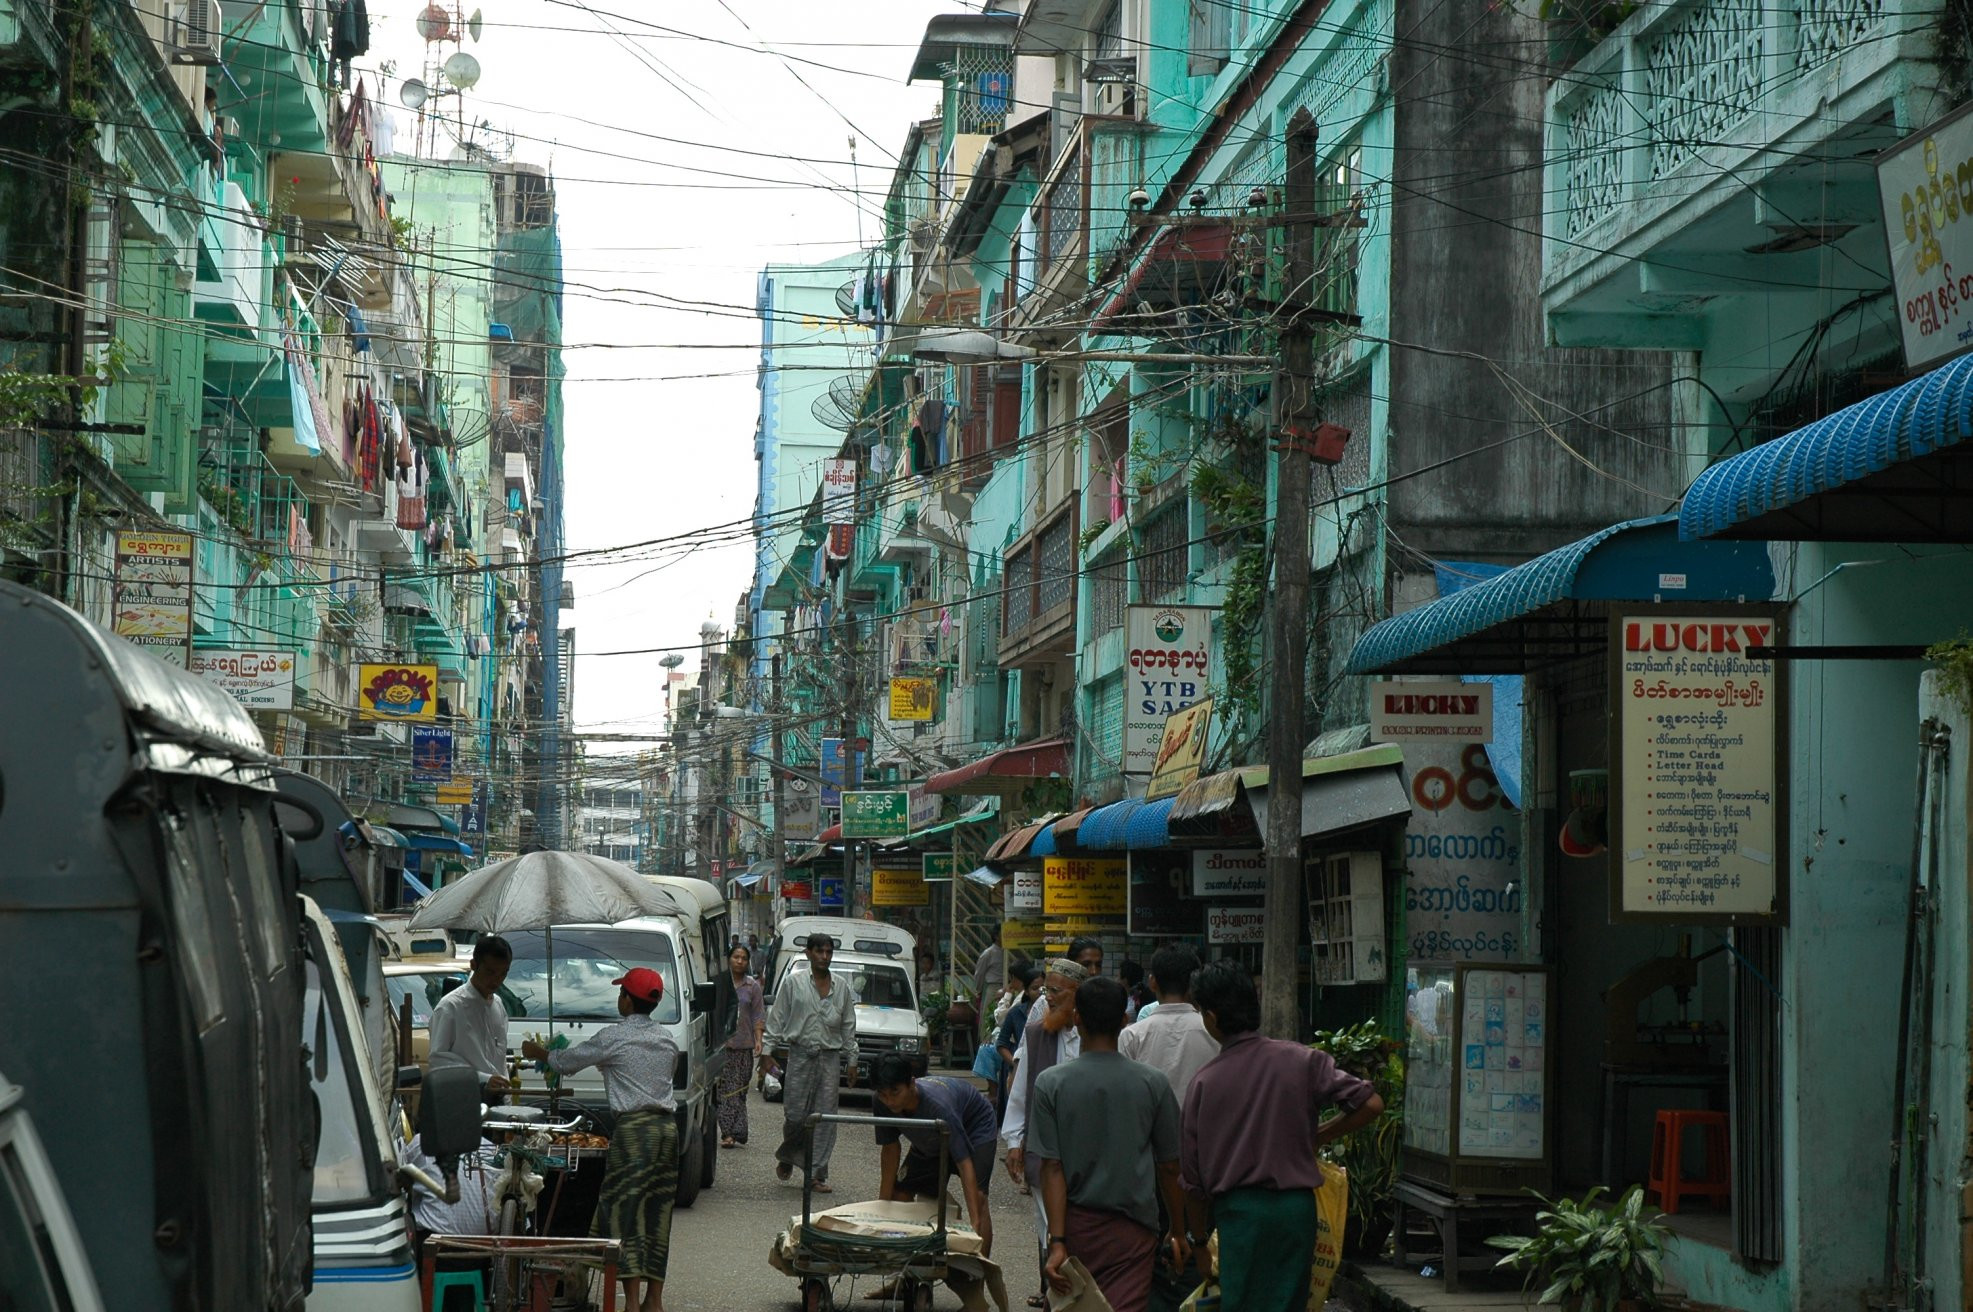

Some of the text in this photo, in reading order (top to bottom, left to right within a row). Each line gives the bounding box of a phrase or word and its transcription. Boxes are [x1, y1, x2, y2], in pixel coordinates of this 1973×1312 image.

[128, 555, 180, 566] ARTISTS
[119, 594, 187, 606] ENGINEERING
[1626, 623, 1771, 653] LUCKY
[1384, 694, 1480, 715] LUCKY
[1656, 750, 1721, 759] Time Cards
[1656, 761, 1724, 770] Letter Head
